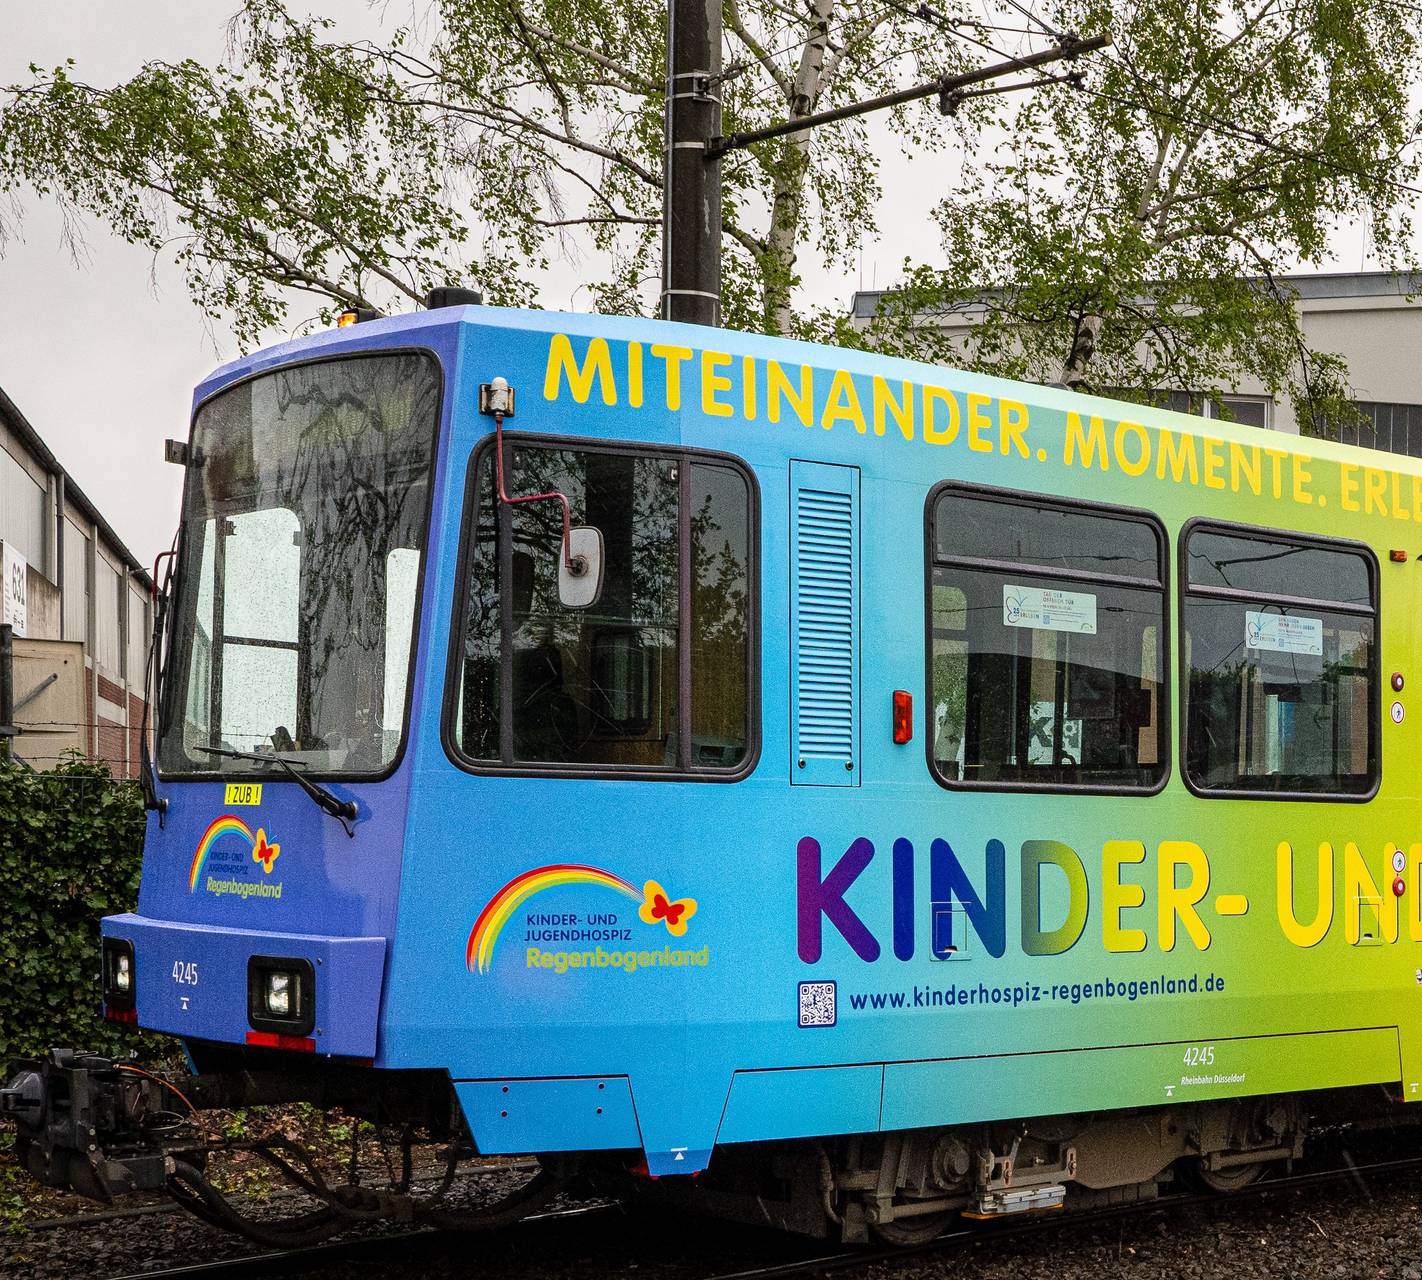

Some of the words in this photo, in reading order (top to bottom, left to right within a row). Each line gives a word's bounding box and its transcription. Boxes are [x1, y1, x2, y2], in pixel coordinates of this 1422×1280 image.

[543, 333, 1047, 462] MITEINANDER.
[1063, 410, 1327, 508] MOMENTE.
[233, 788, 252, 803] ZUB
[206, 876, 282, 899] Regenbogenland
[797, 836, 1249, 964] KINDER-
[527, 914, 583, 926] KINDER-
[587, 914, 618, 926] UND
[524, 929, 632, 942] JUGENDHOSPIZ
[526, 944, 709, 974] Regenbogenland
[172, 960, 198, 985] 4245
[849, 973, 1225, 1011] www.kinderhospiz-regenbogenland.de
[1183, 1046, 1215, 1066] 4245
[1181, 1075, 1213, 1085] Rheinbahn
[1213, 1072, 1246, 1084] Düsseldorf
